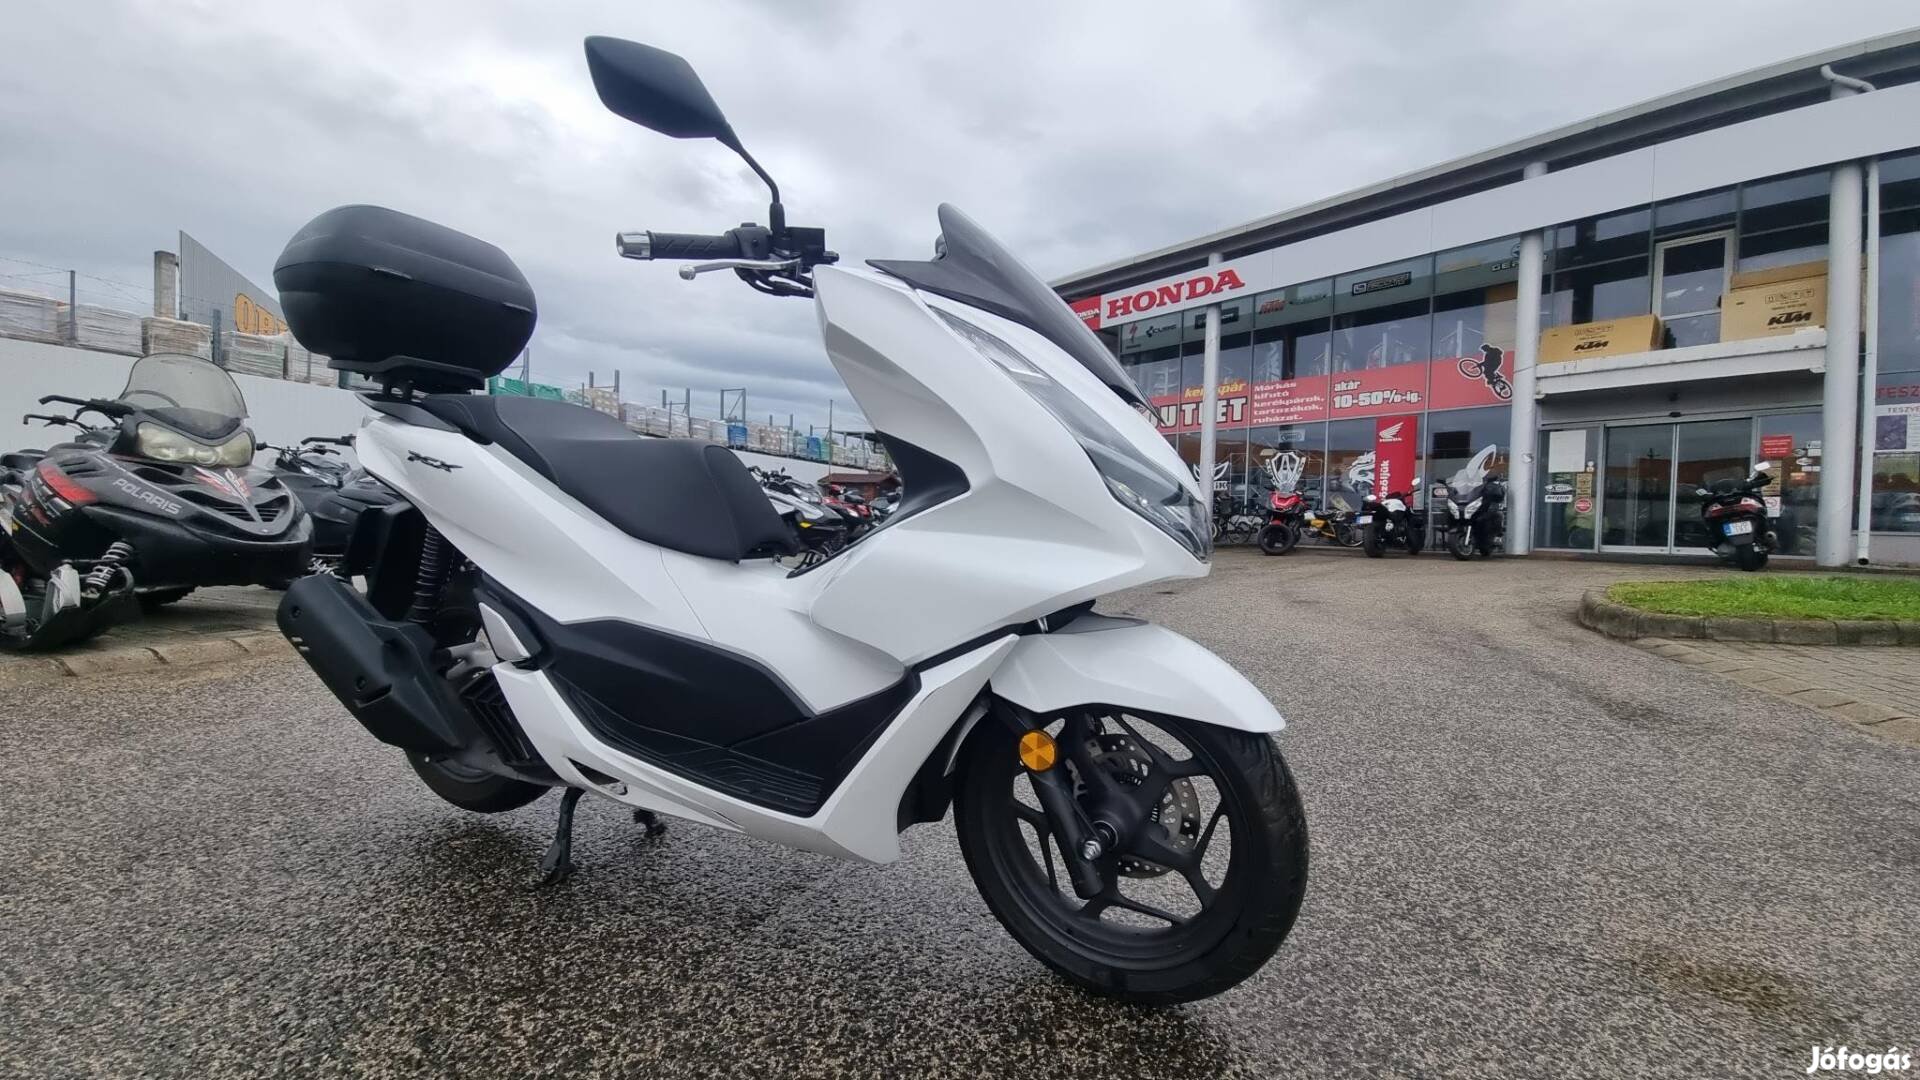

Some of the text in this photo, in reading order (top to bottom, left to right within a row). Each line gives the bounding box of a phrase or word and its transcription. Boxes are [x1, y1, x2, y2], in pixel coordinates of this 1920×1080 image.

[1107, 269, 1246, 319] HONDA
[1076, 308, 1100, 319] ONDA
[1767, 310, 1813, 326] KTM
[1573, 340, 1609, 351] KTM
[1184, 382, 1247, 400] kepár
[1334, 380, 1361, 392] akár
[1333, 389, 1423, 409] 10-50%-ig.
[1379, 459, 1391, 500] özöljük
[112, 477, 183, 516] POLARIS
